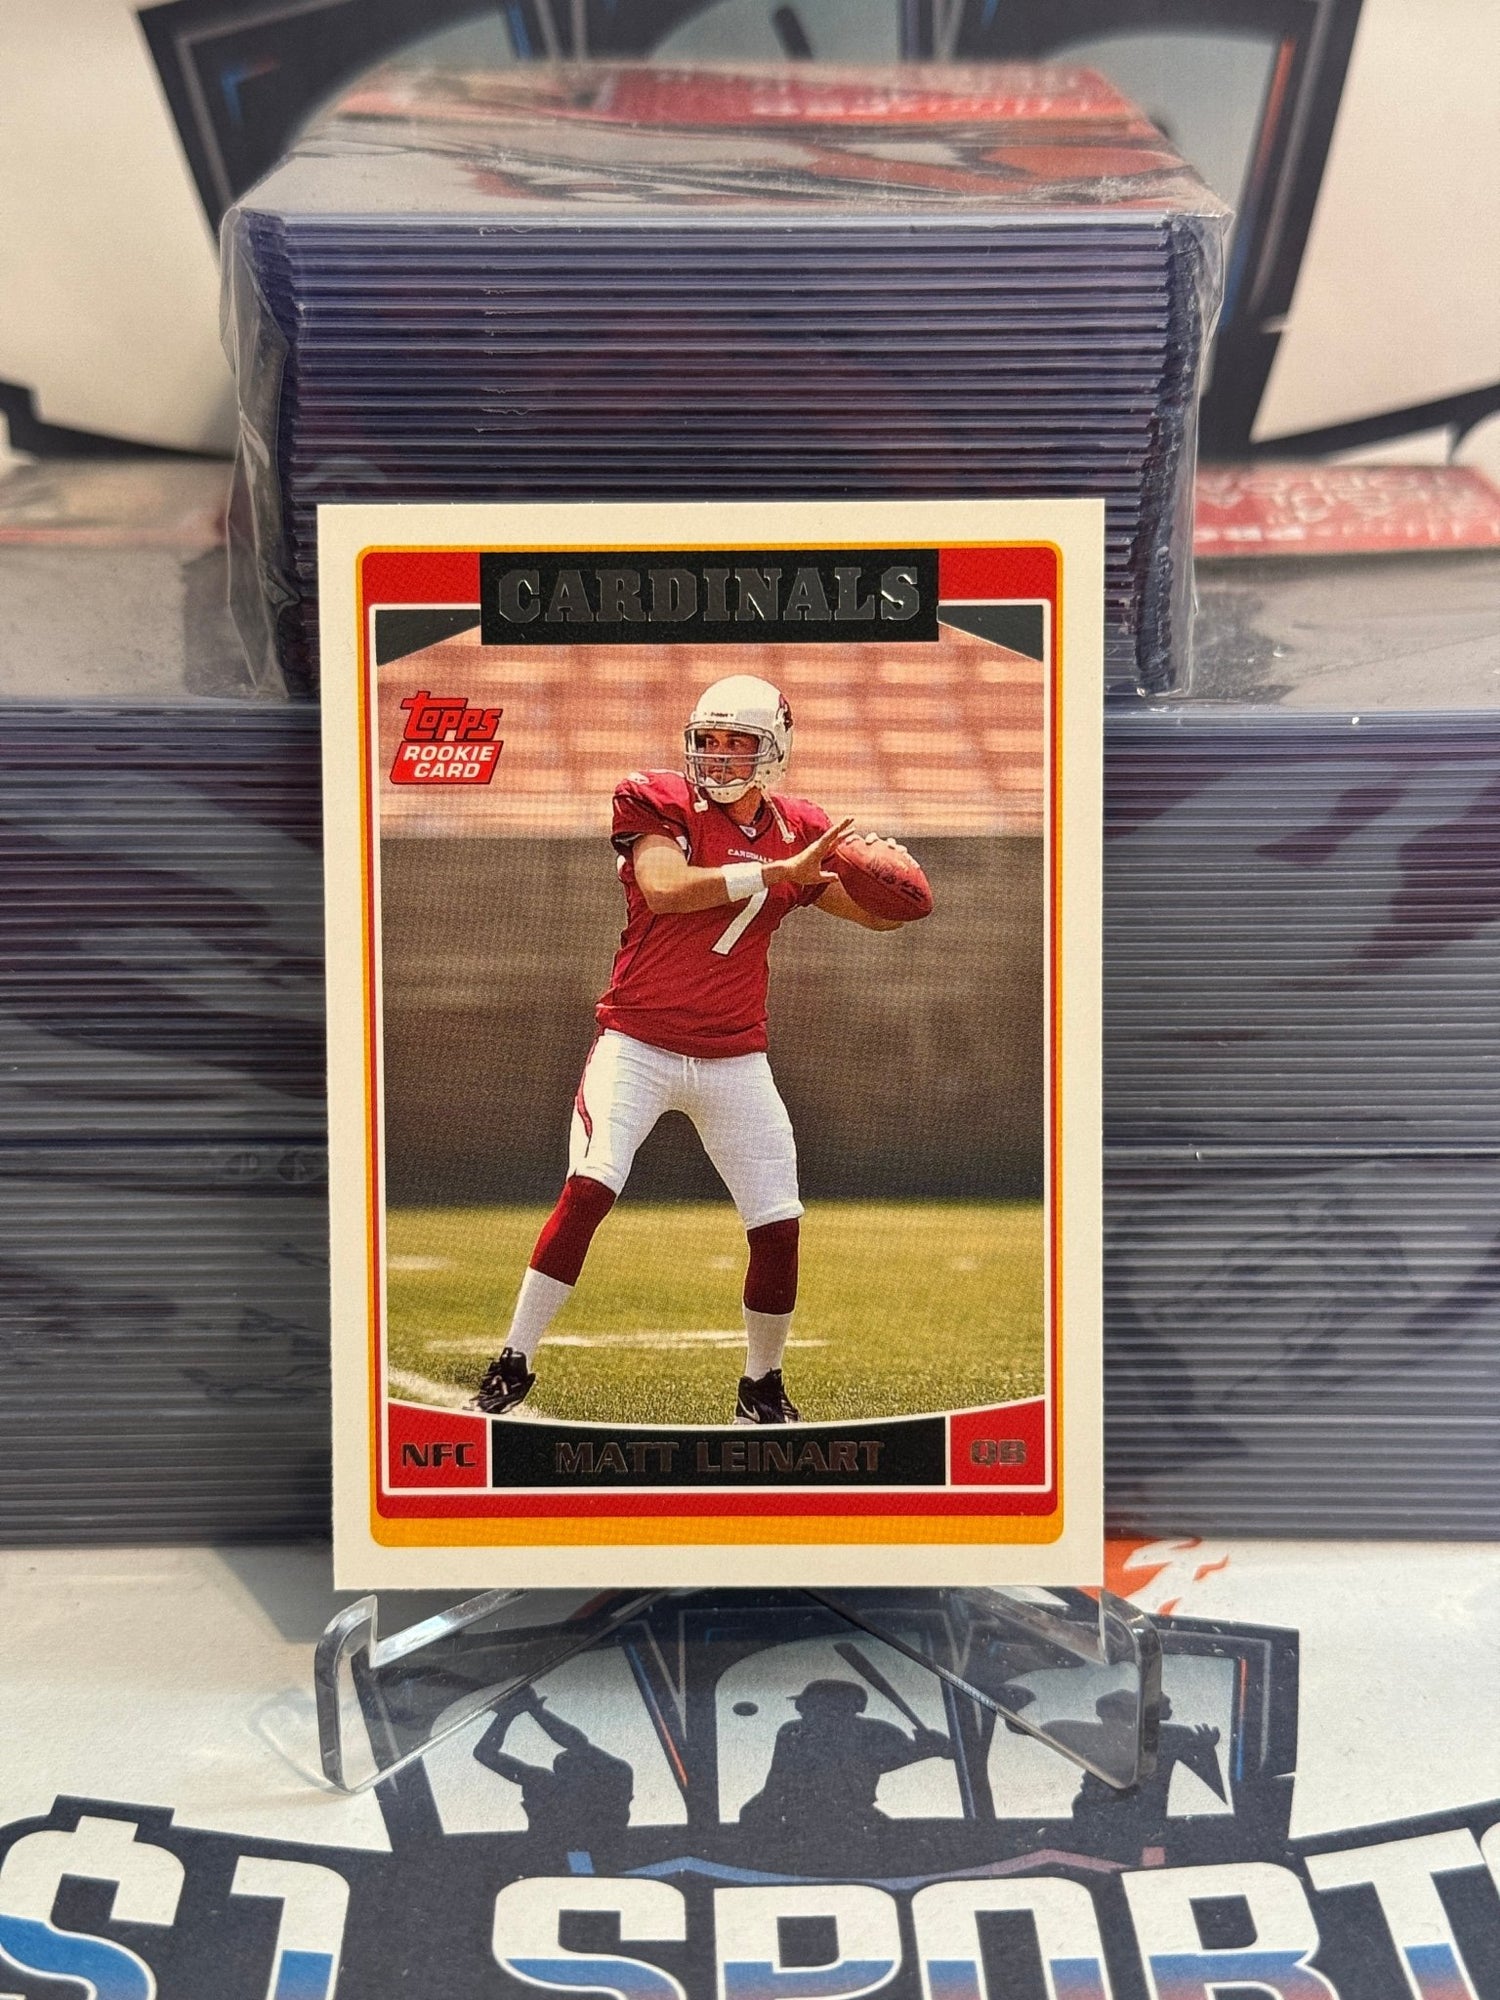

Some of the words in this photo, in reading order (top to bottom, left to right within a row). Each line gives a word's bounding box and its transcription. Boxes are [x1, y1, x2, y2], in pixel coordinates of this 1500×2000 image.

[499, 566, 921, 623] CARDINALS
[403, 745, 494, 762] ROOKIE
[414, 762, 480, 778] CARD
[711, 885, 769, 956] 7
[401, 1442, 476, 1468] NFC
[555, 1441, 680, 1473] MATT
[696, 1440, 885, 1473] LEINART
[970, 1438, 1028, 1467] QB
[492, 1822, 1500, 2000] SPORT
